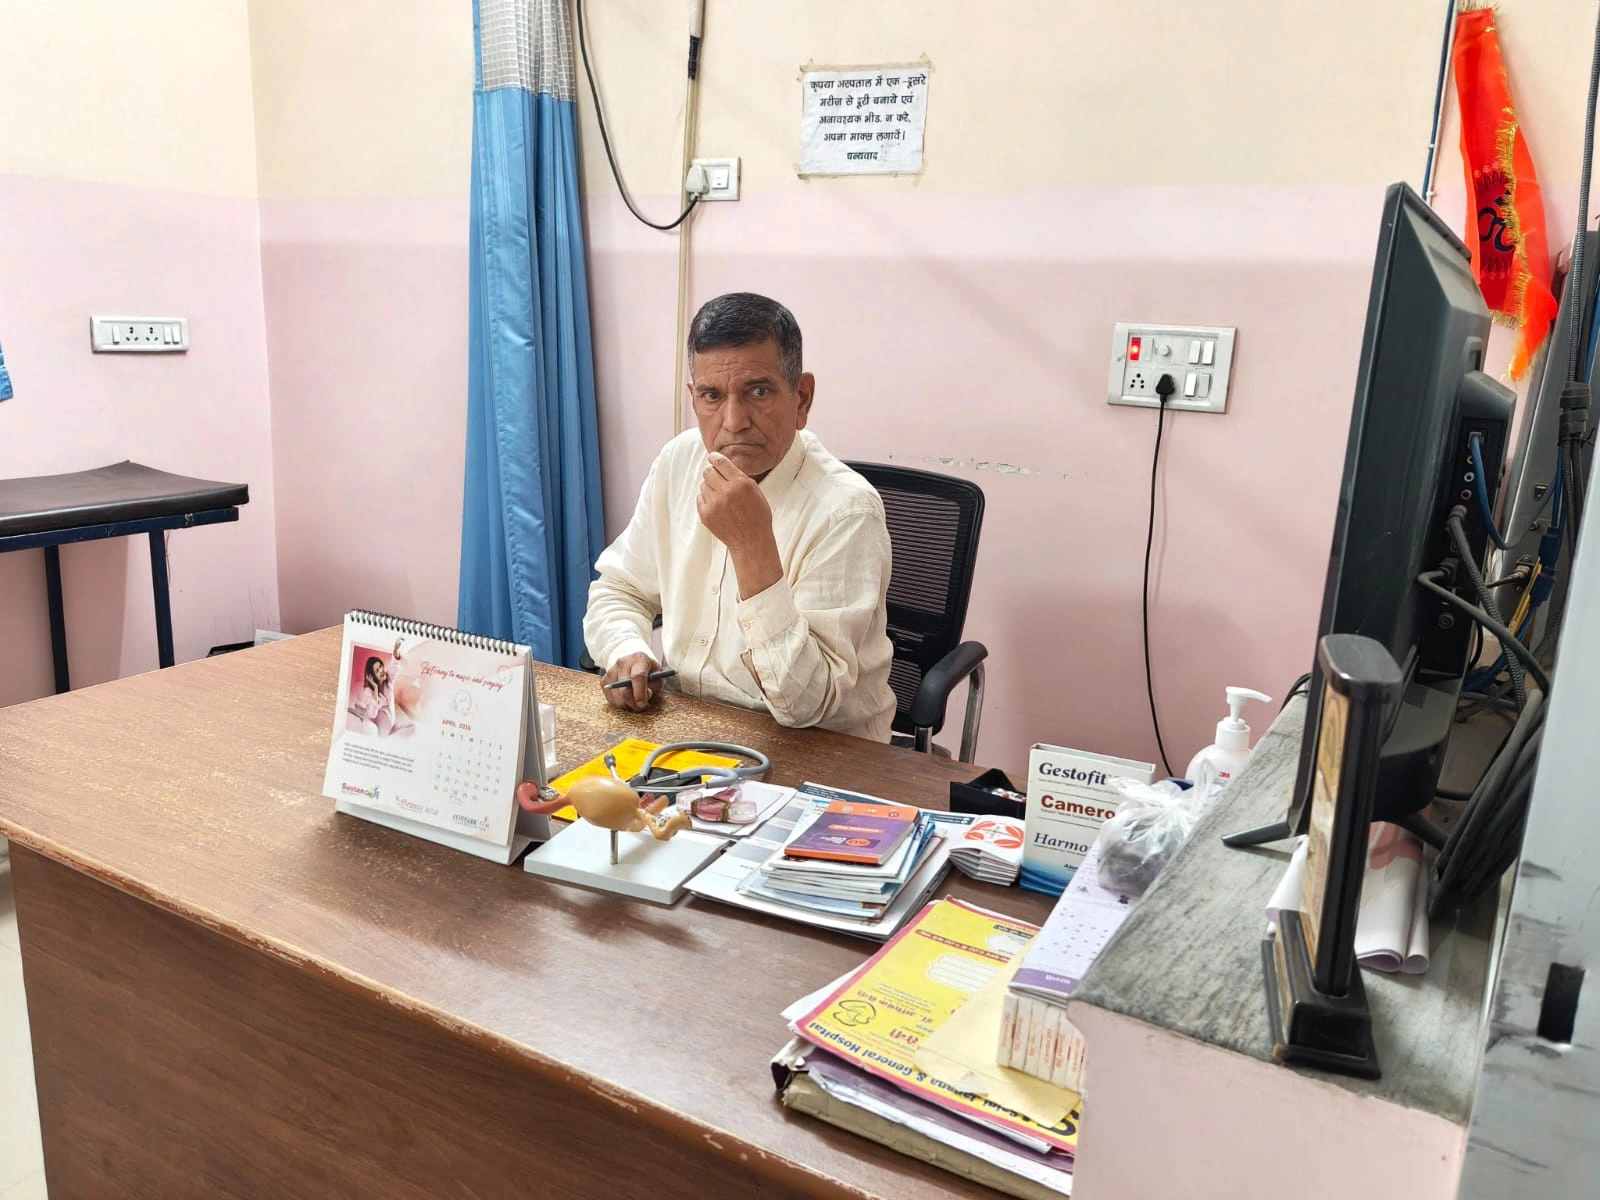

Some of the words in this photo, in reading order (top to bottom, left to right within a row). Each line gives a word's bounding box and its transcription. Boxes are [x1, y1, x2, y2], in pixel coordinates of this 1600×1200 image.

[810, 80, 834, 92] कृपया
[837, 79, 872, 88] अस्पताल
[875, 75, 883, 87] में
[886, 77, 900, 87] एक
[845, 94, 853, 106] से
[856, 93, 870, 109] दूरी
[901, 91, 914, 105] एवं
[819, 115, 862, 124] अनावश्यक
[885, 114, 893, 122] न
[823, 133, 847, 142] अपना
[846, 152, 878, 160] धन्यवाद
[1039, 762, 1107, 786] Gestofit
[809, 1021, 862, 1054] Hospital
[861, 1049, 913, 1076] General
[916, 1070, 928, 1083] &
